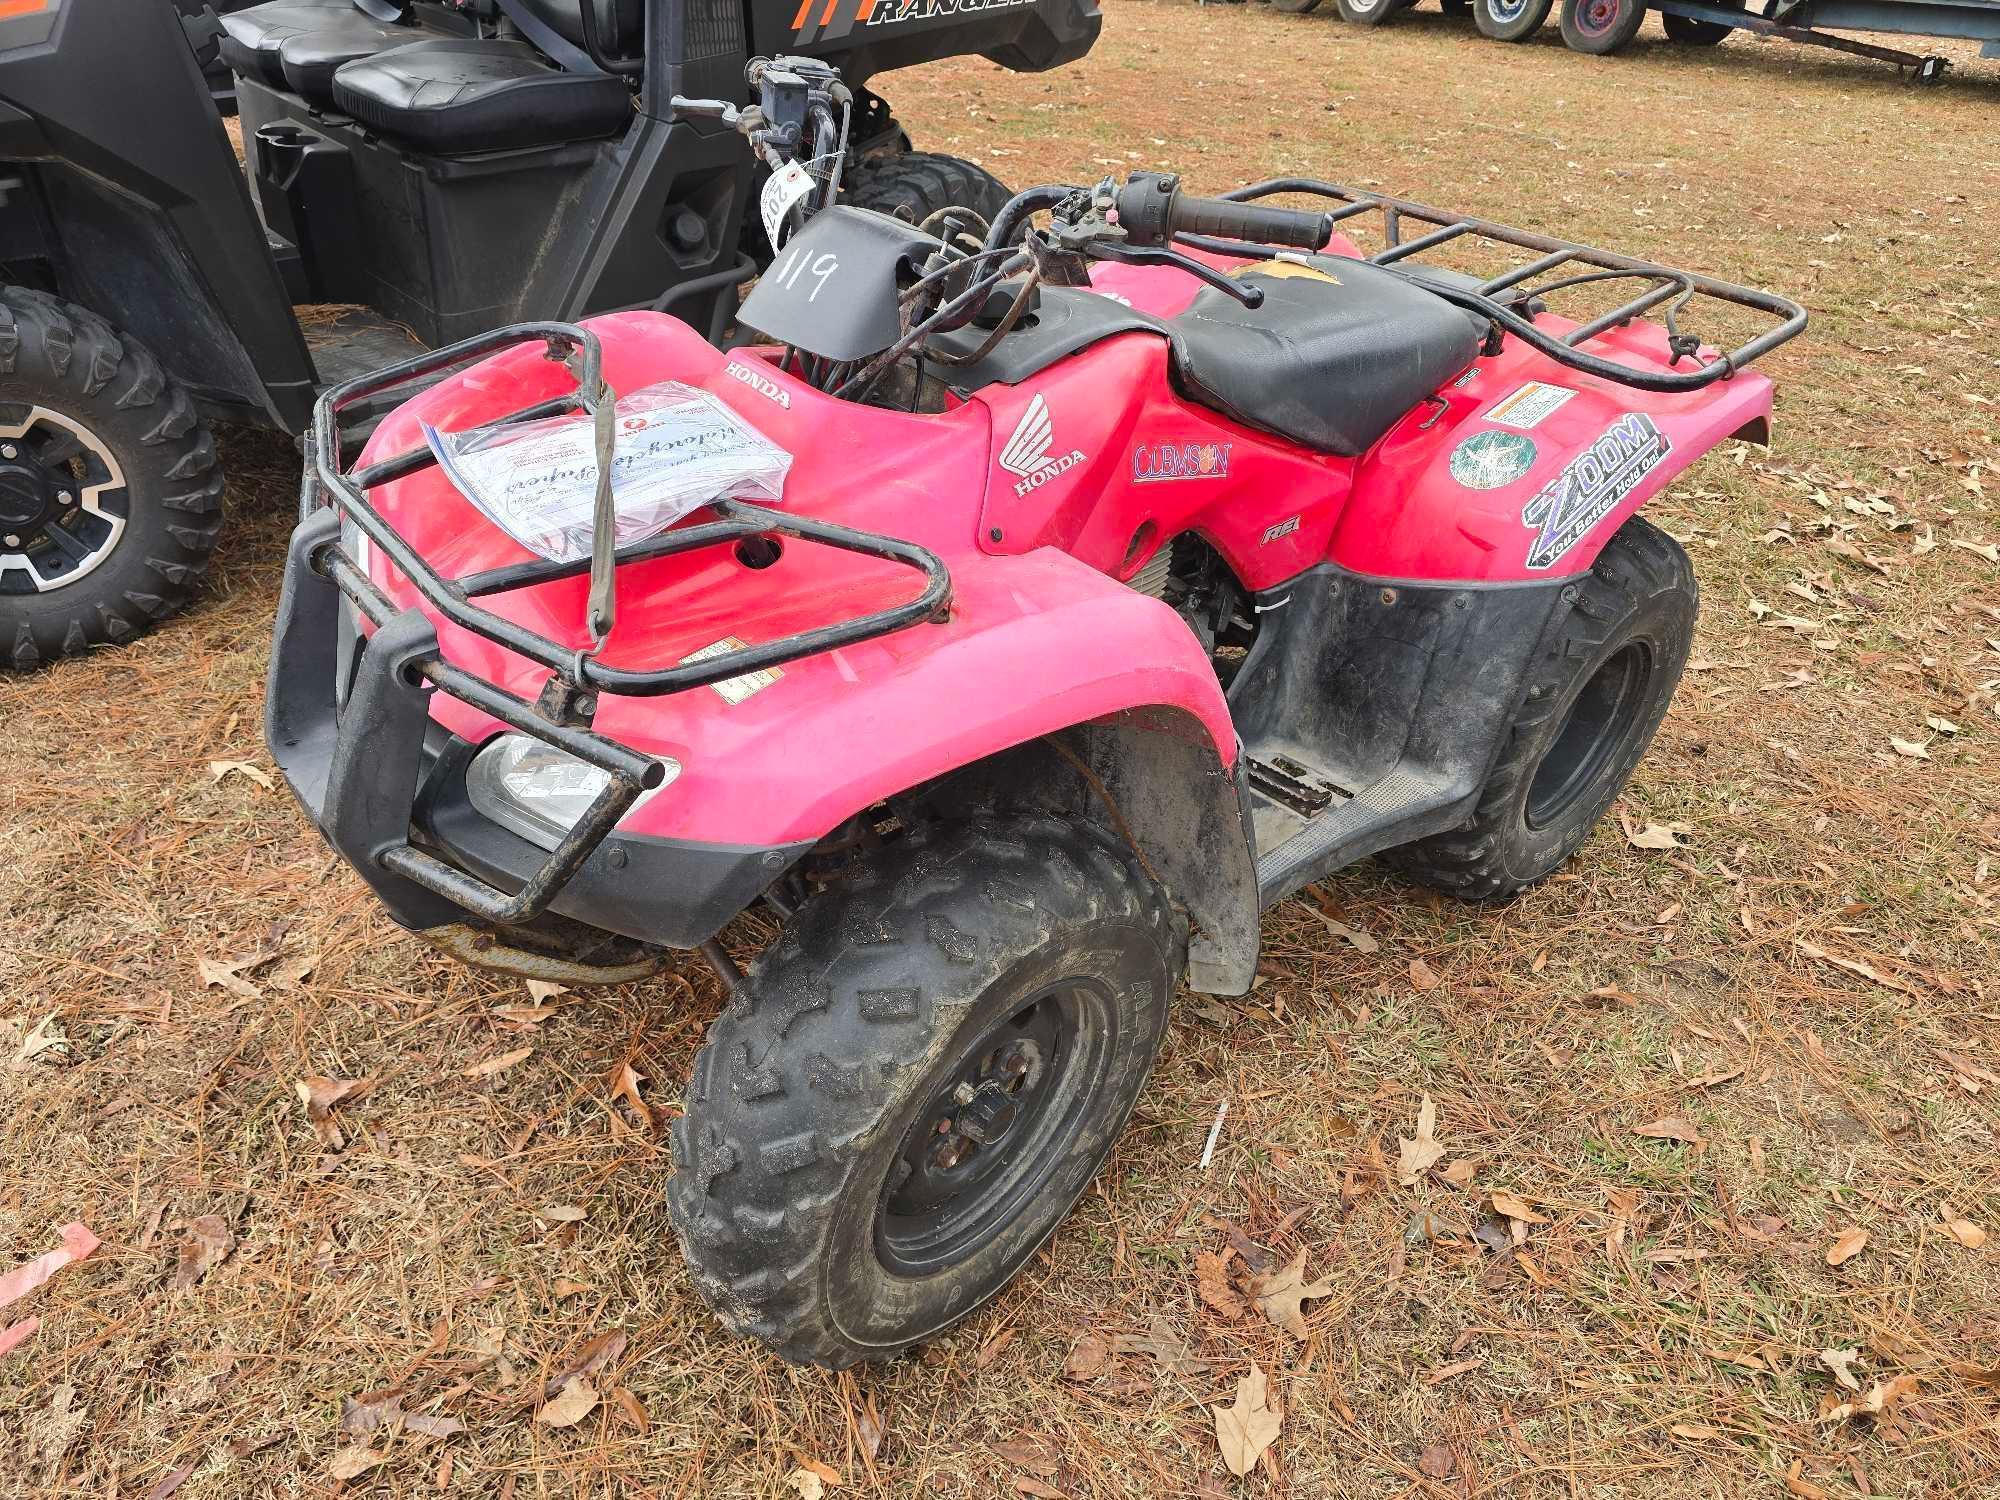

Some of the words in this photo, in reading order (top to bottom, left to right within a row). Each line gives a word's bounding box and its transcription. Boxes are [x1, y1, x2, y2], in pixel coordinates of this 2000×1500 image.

[776, 248, 839, 303] 119
[725, 360, 791, 409] HONDA
[1013, 450, 1087, 497] HONDA
[1522, 413, 1658, 562] ZOOM
[1544, 533, 1573, 559] You
[1575, 494, 1615, 535] Better
[1615, 466, 1641, 496] Hold
[1641, 450, 1660, 469] On!
